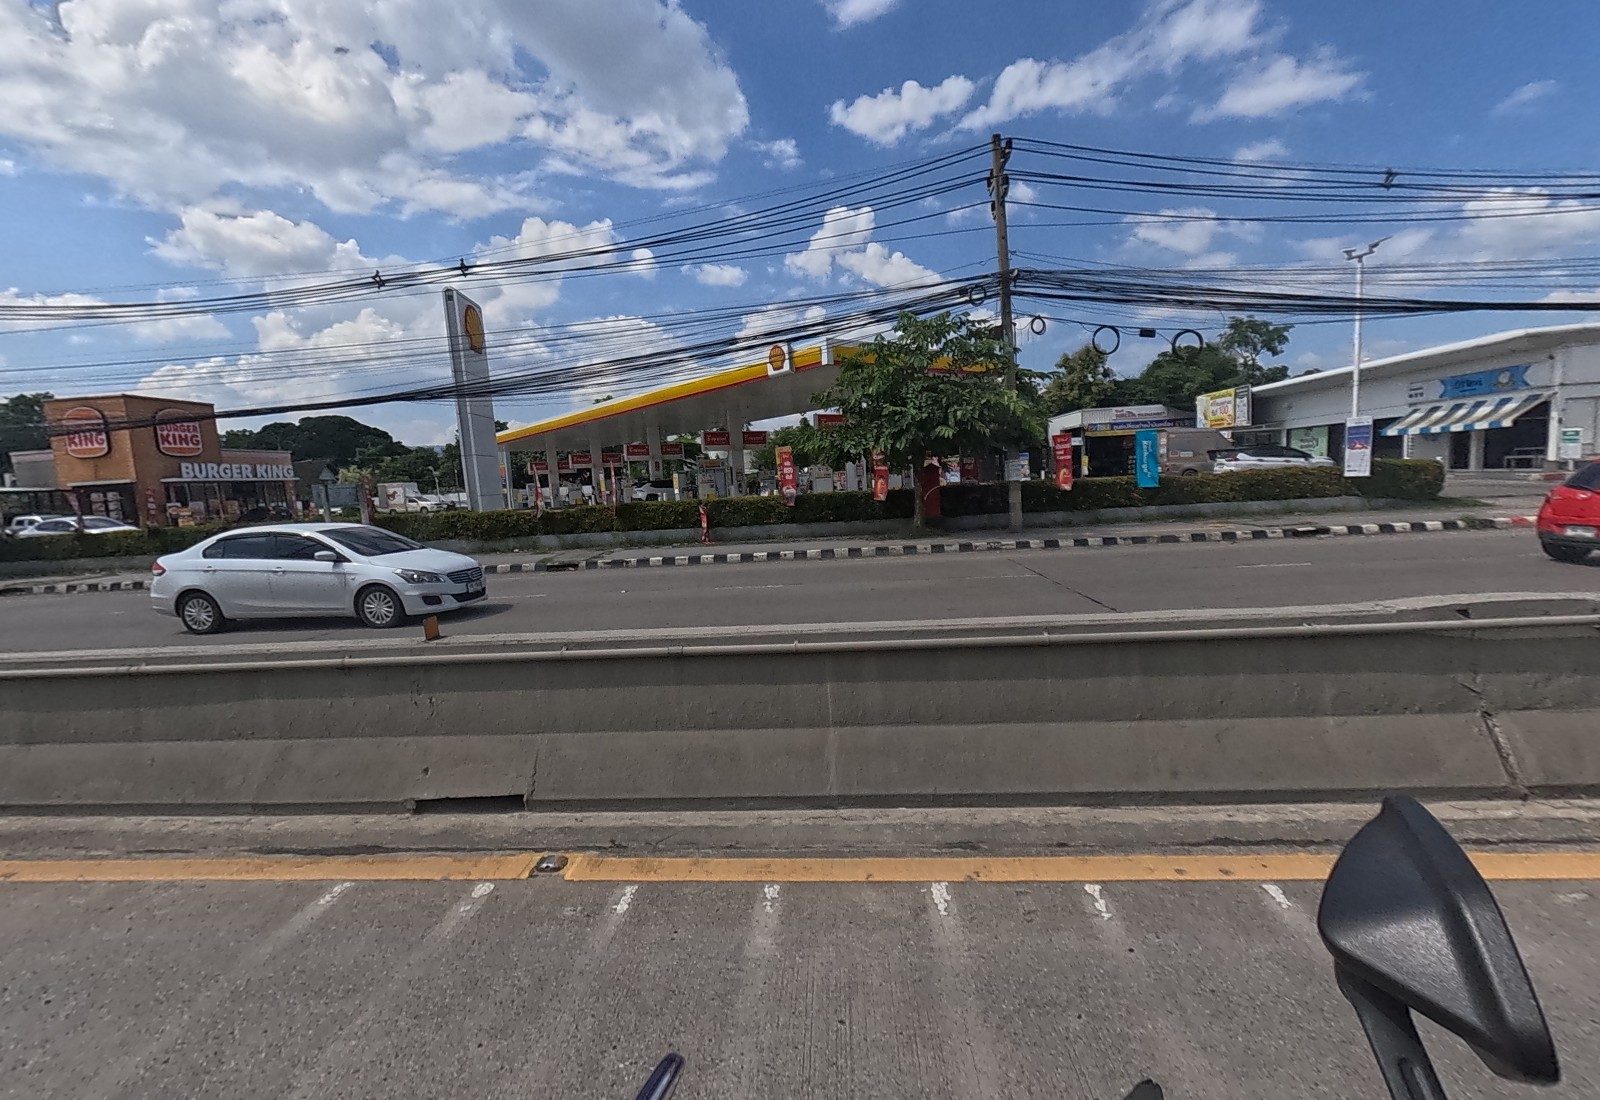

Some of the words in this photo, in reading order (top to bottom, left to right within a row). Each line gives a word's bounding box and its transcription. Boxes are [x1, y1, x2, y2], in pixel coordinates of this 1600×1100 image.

[159, 423, 199, 433] BURGER
[67, 431, 105, 448] KING
[160, 433, 200, 446] KING
[180, 462, 253, 479] BURGER
[256, 463, 294, 478] KING
